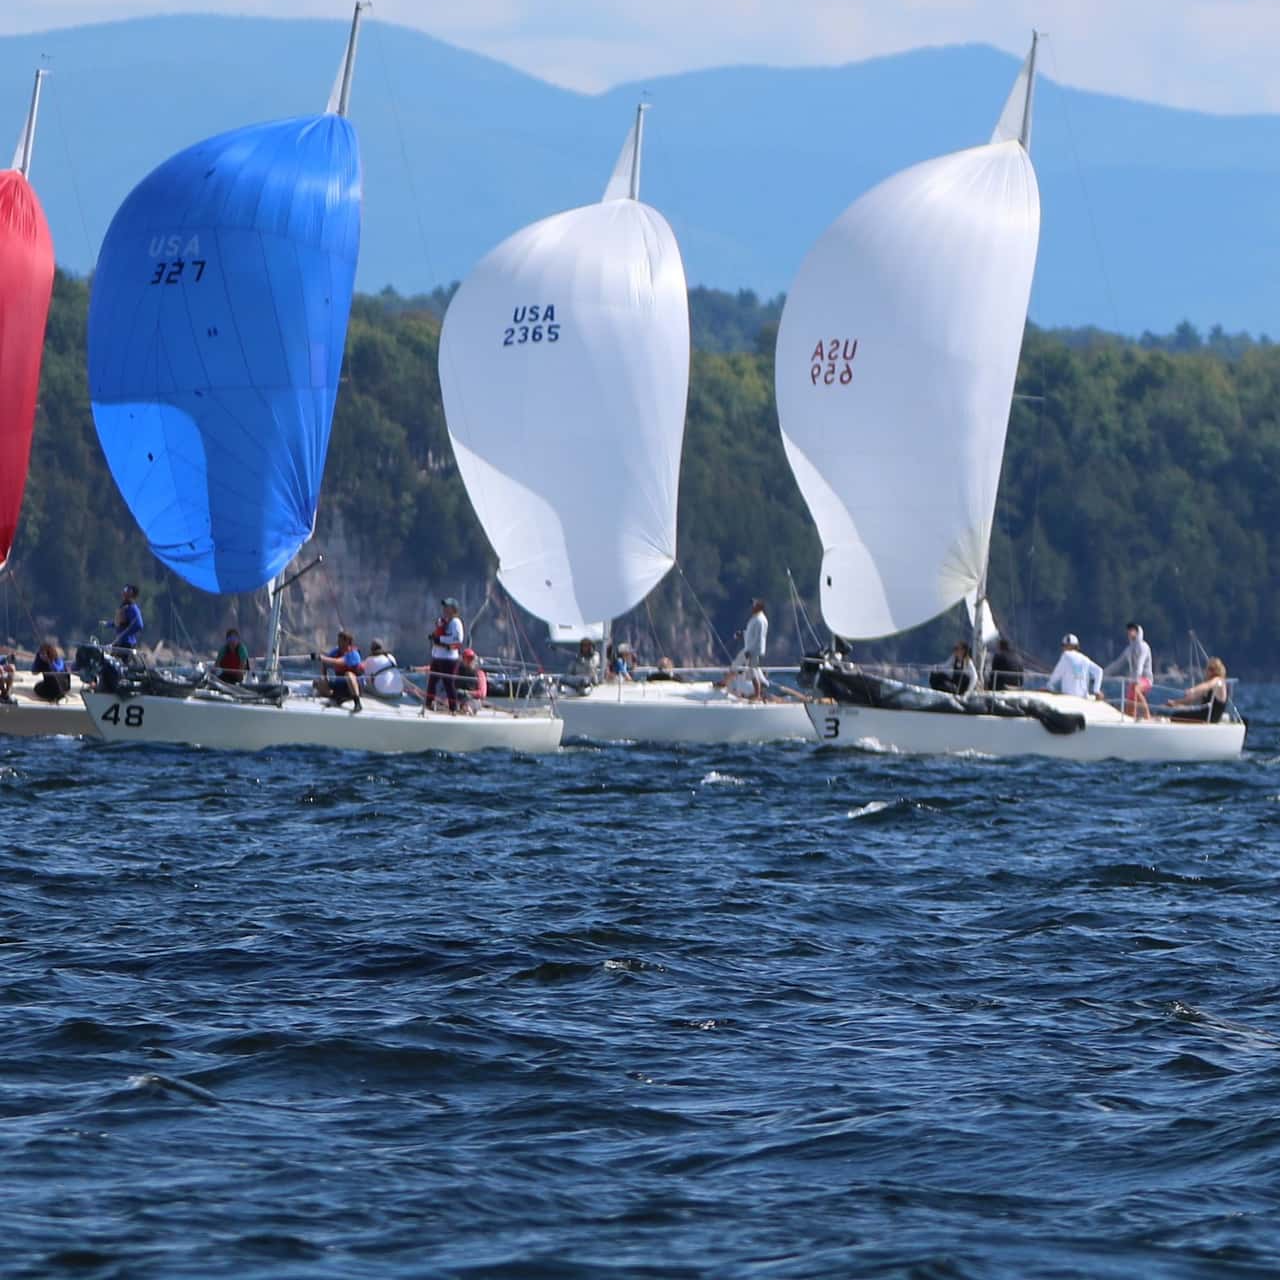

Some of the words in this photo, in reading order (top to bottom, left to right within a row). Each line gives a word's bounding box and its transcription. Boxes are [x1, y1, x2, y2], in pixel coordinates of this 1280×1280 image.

[148, 232, 200, 257] USA
[150, 259, 207, 285] 327
[513, 303, 556, 324] USA
[502, 324, 561, 347] 2365
[101, 703, 145, 727] 48
[823, 717, 840, 739] 3
